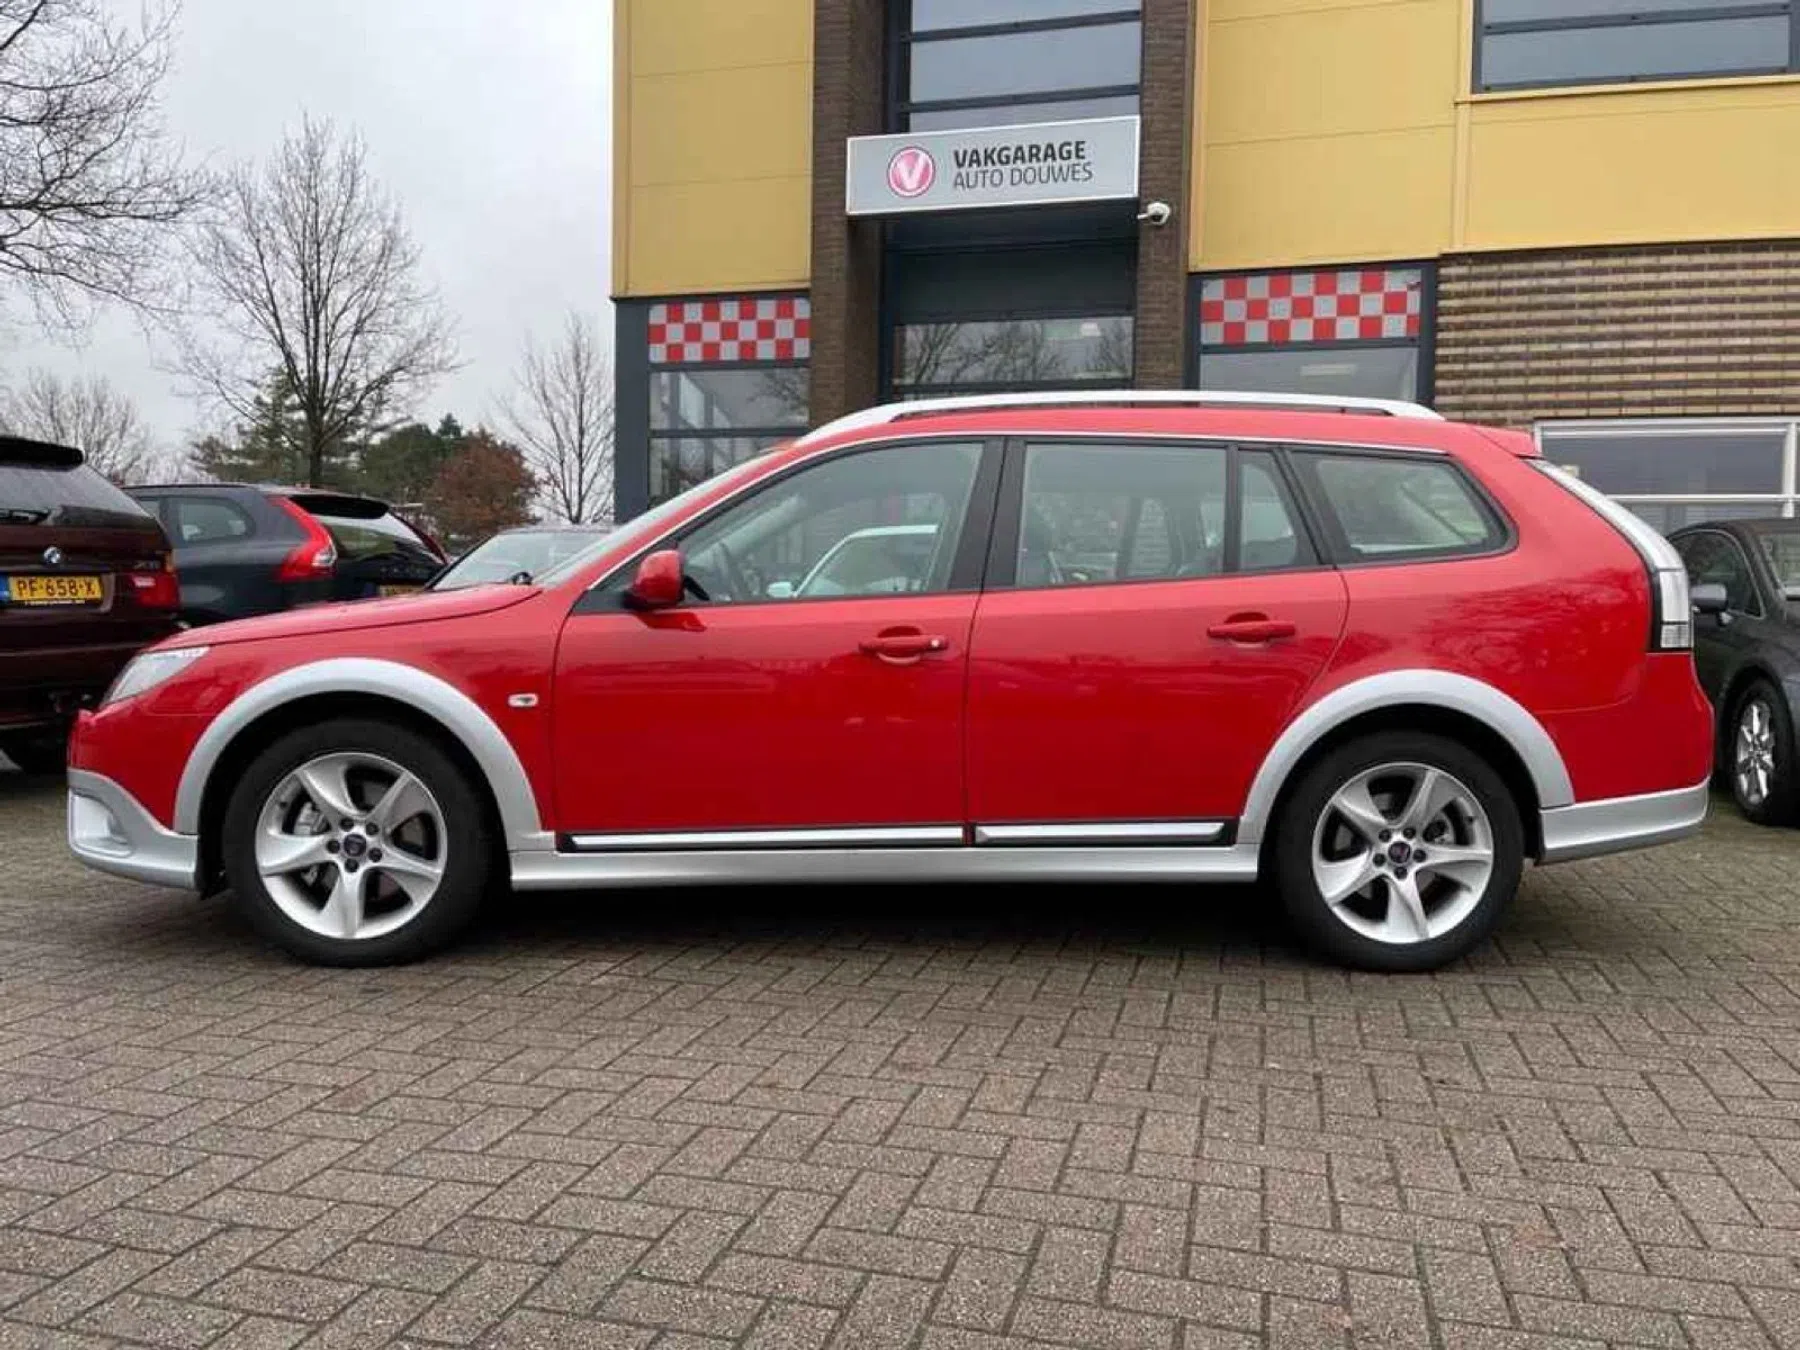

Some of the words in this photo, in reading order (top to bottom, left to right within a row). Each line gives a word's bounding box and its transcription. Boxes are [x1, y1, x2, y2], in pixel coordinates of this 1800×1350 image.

[953, 140, 1086, 168] VAKGARAGE
[894, 152, 929, 191] V
[953, 168, 1003, 190] AUTO
[1009, 162, 1093, 186] DOUWES
[16, 578, 96, 597] PF-658-X
